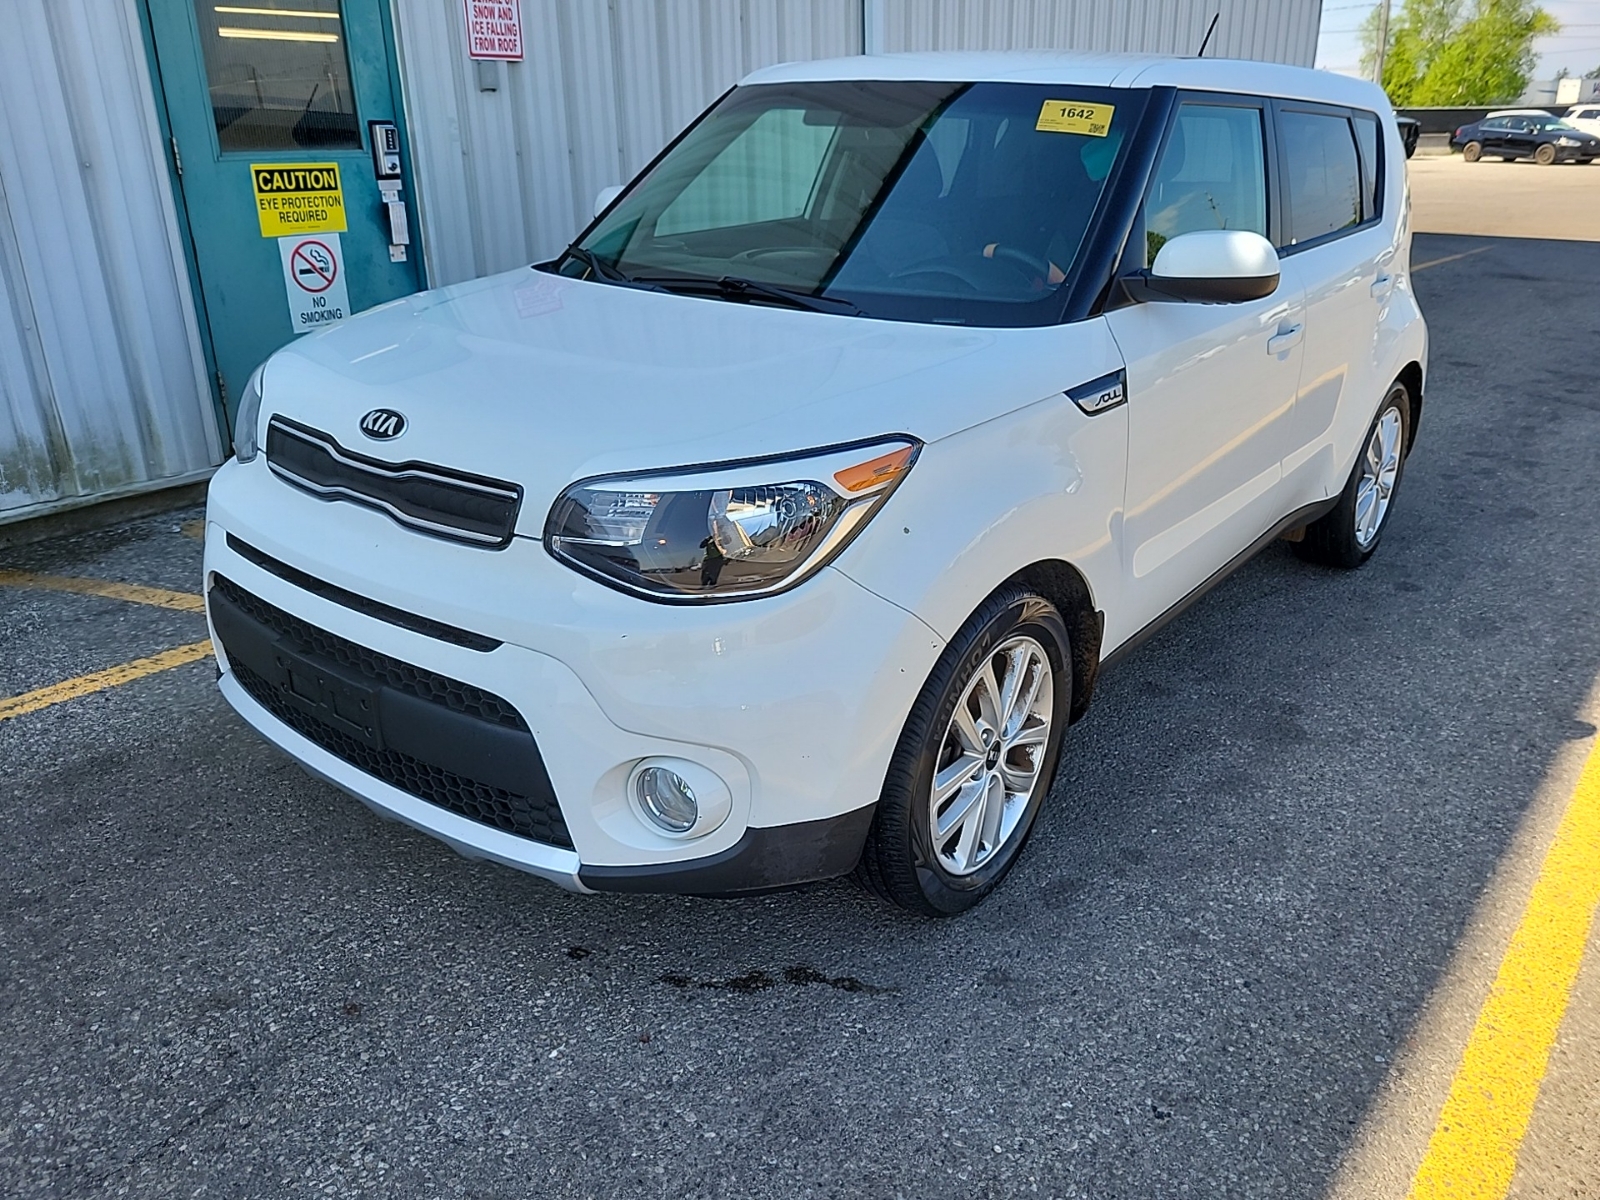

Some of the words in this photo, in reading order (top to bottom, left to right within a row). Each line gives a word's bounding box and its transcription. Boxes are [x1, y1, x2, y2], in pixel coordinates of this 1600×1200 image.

[473, 5, 496, 20] SNOW
[498, 7, 513, 21] AND
[472, 21, 484, 35] ICE
[486, 21, 518, 37] FALLING
[475, 37, 496, 51] FROM
[498, 38, 517, 52] ROOF
[1060, 107, 1095, 120] 1642
[258, 170, 336, 191] CAUTION
[259, 197, 279, 211] EYE
[281, 195, 341, 210] PROTECTION
[279, 209, 328, 223] REQUIRED
[312, 296, 326, 308] NO
[300, 308, 343, 324] SMOKING
[362, 411, 399, 436] KIA
